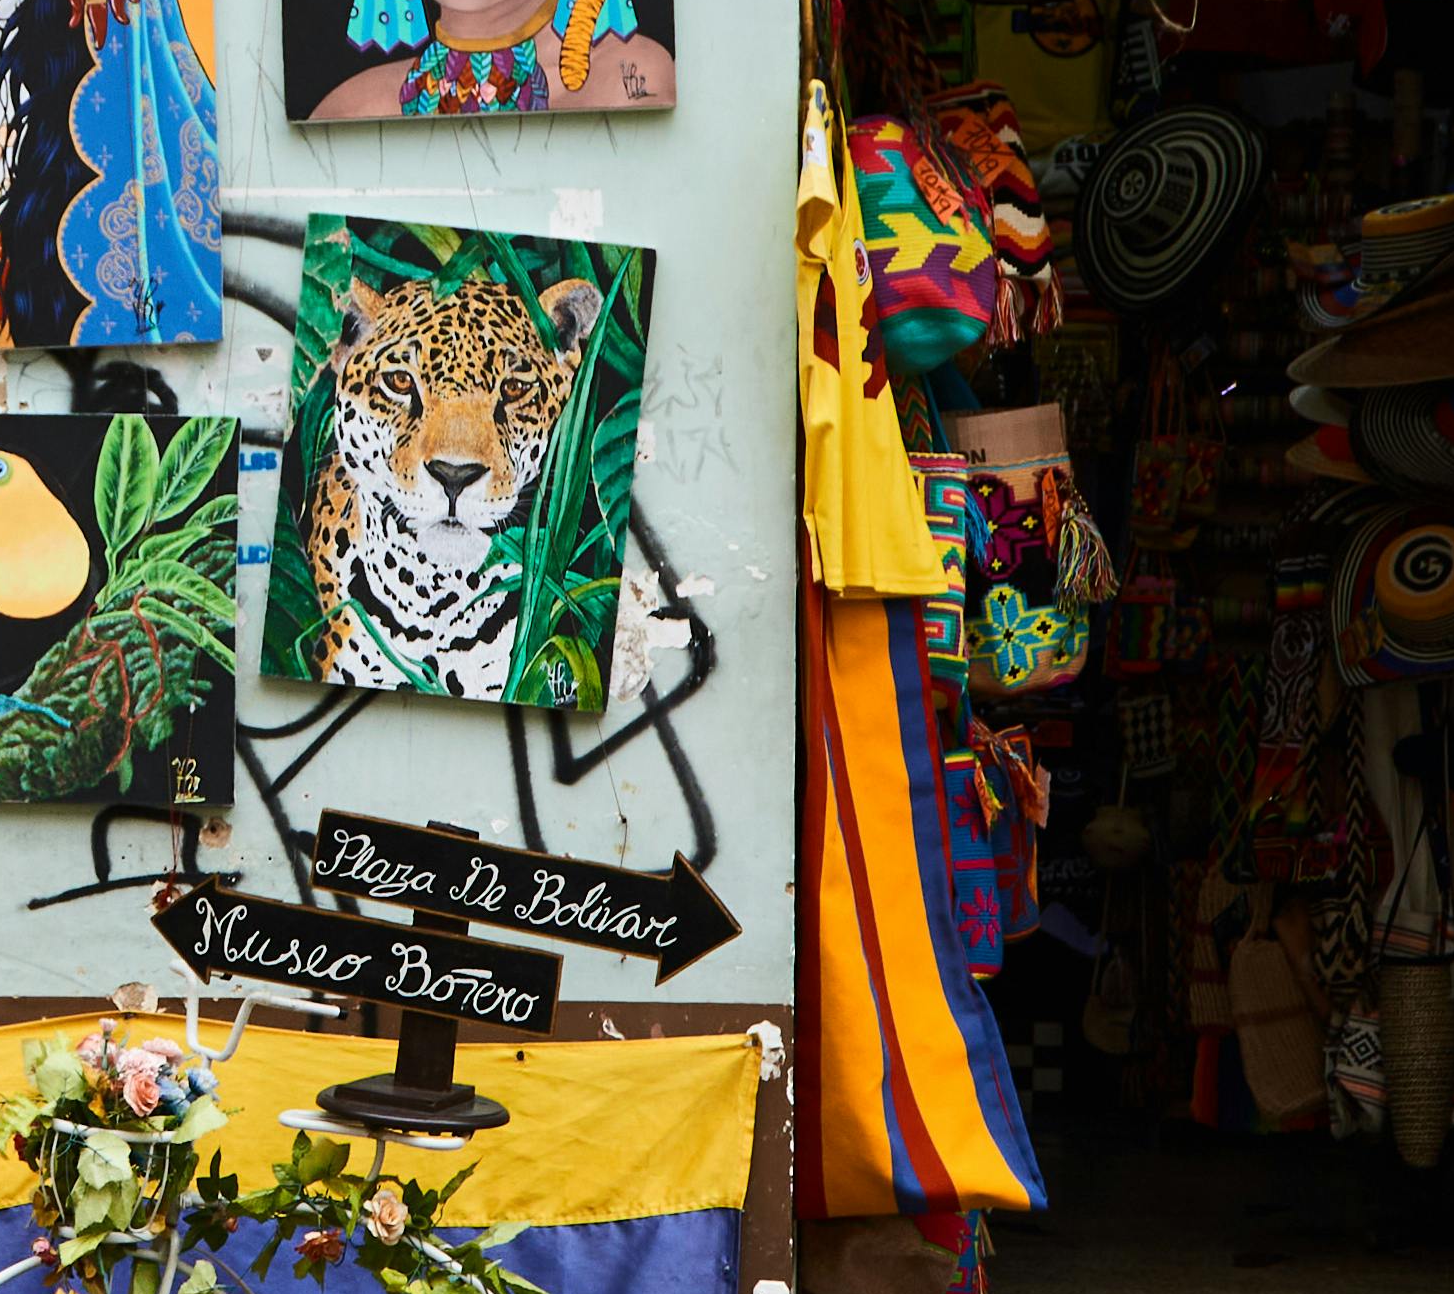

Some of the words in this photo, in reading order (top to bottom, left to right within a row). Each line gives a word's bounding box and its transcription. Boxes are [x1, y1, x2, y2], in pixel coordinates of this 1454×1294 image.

[316, 829, 436, 898] Plaza
[449, 856, 508, 912] De
[194, 897, 372, 981] Museo
[385, 942, 541, 1023] Botero
